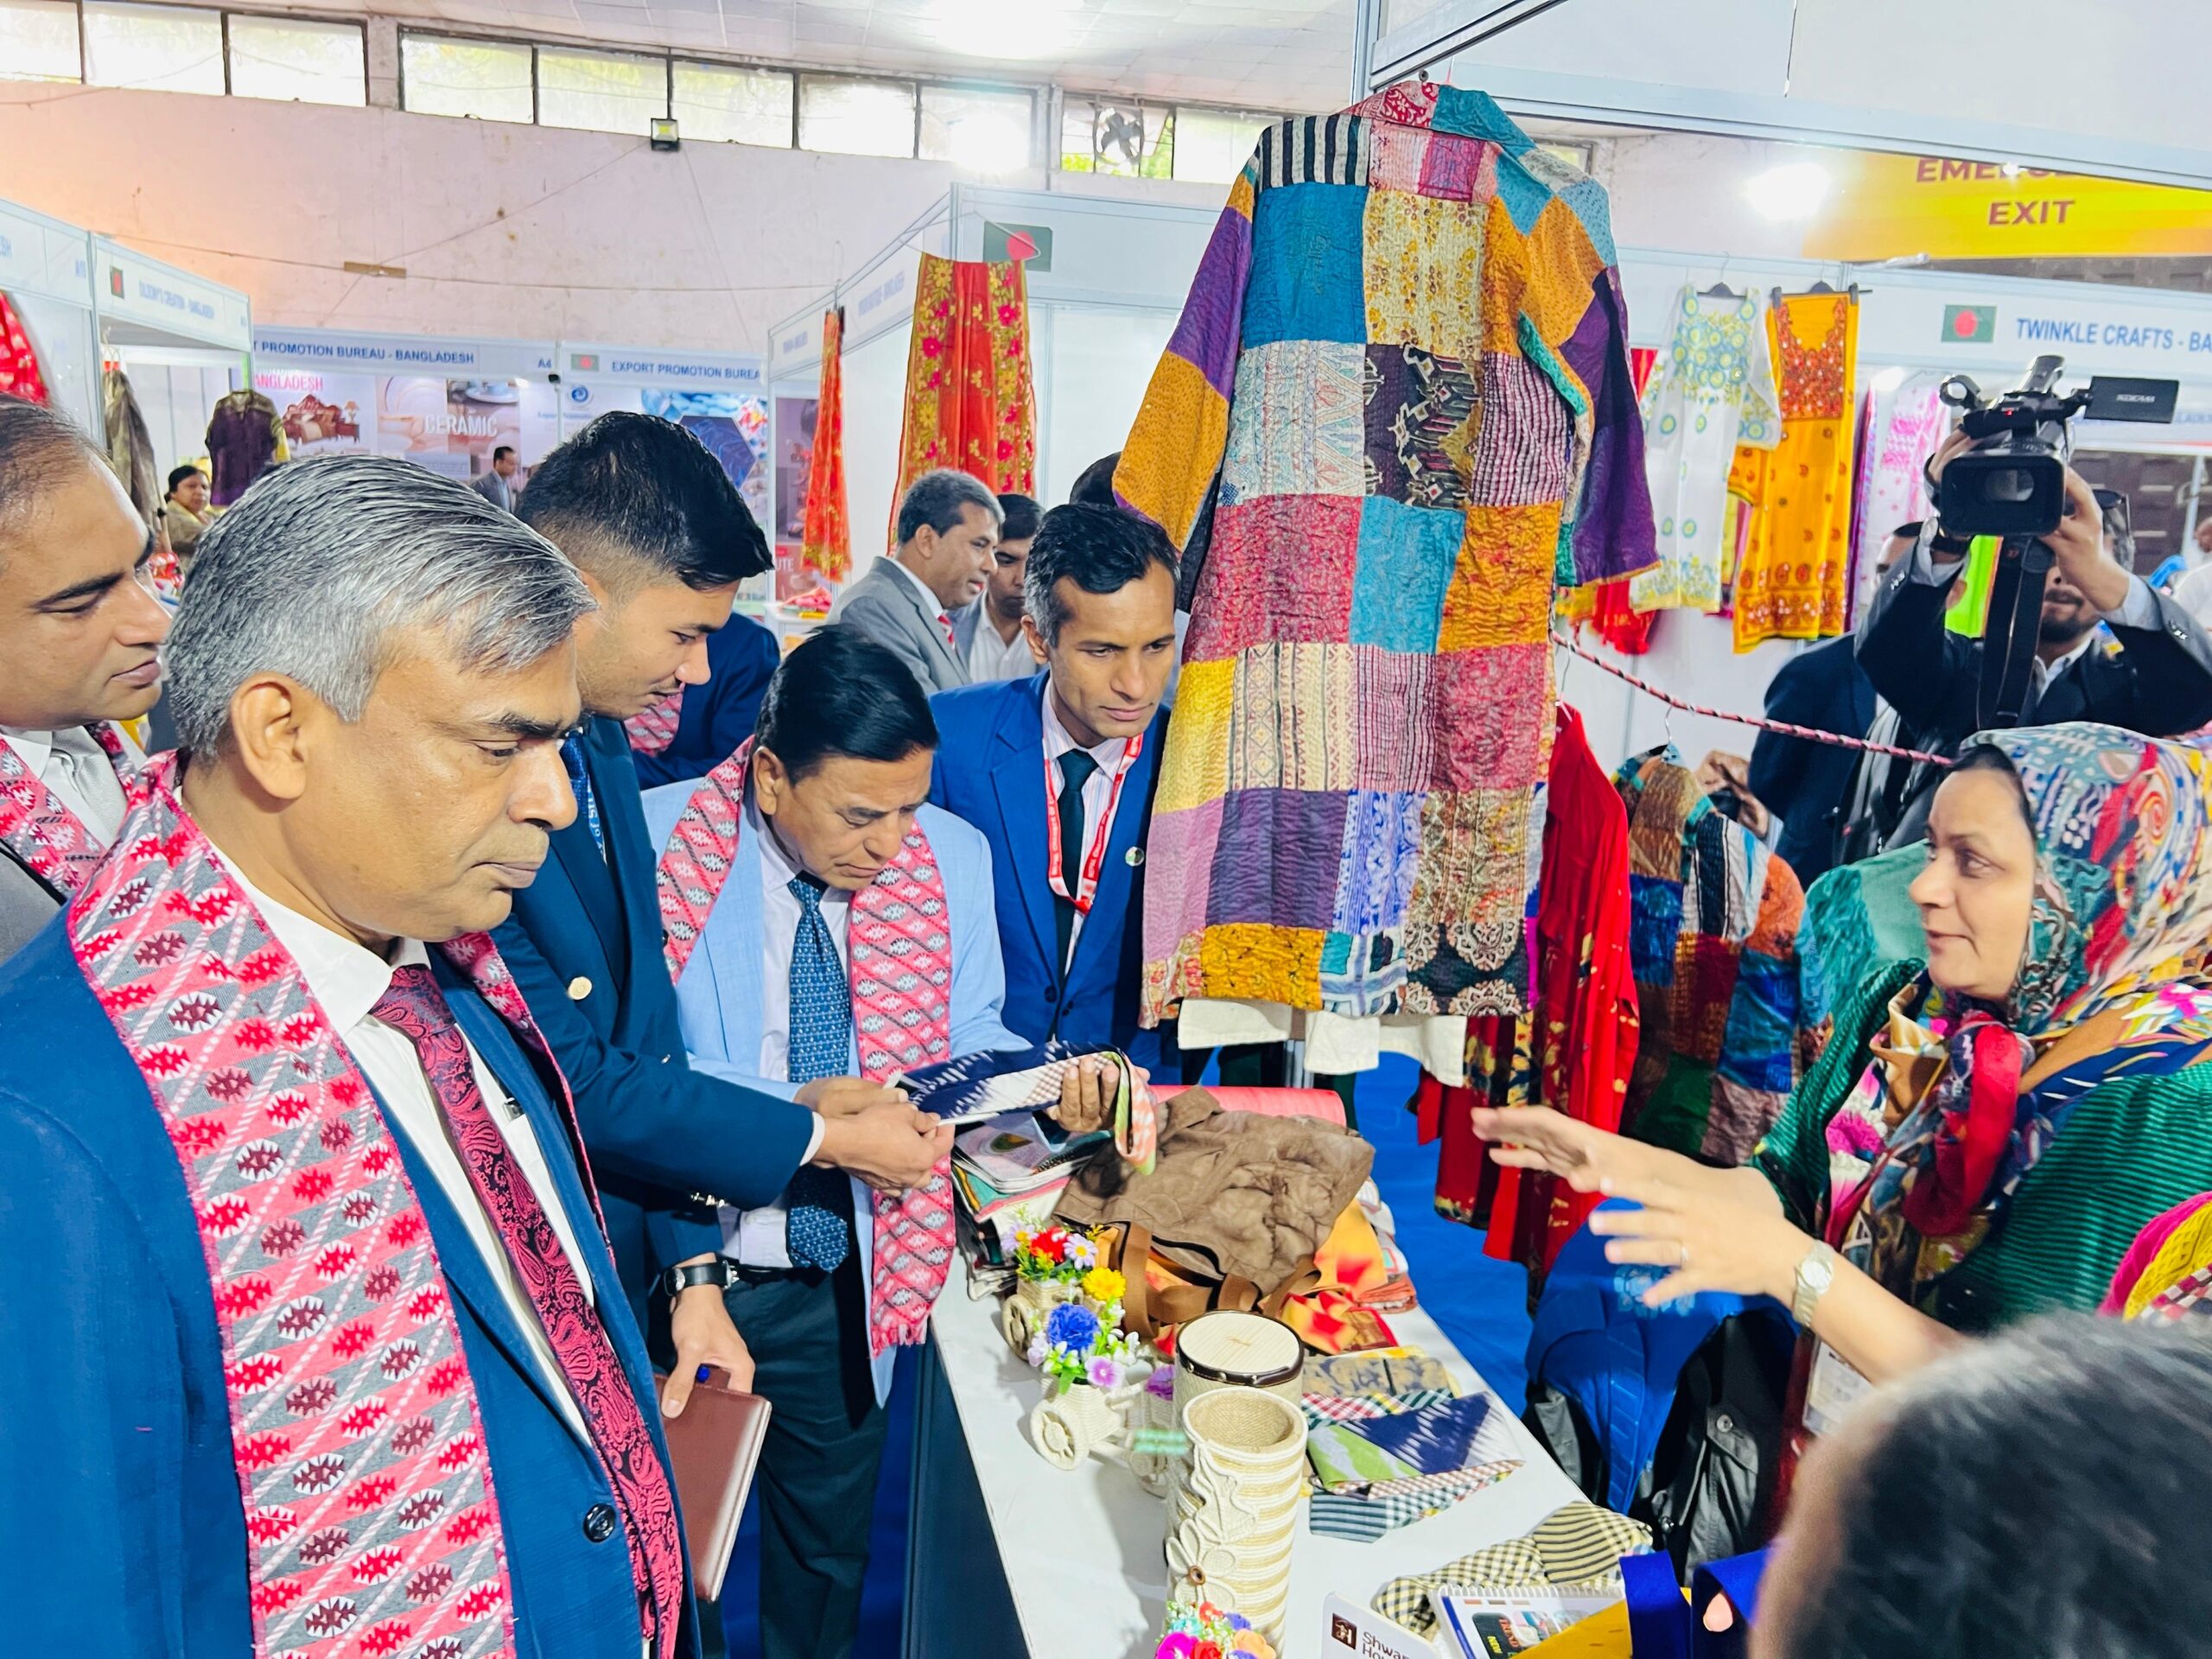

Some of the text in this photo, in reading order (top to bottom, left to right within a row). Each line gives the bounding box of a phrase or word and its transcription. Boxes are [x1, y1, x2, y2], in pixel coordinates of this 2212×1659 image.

[1988, 200, 2075, 226] EXIT
[2016, 318, 2100, 345] TWINKLE
[2102, 324, 2174, 350] CRAFTS
[262, 340, 334, 356] PROMOTION
[336, 345, 385, 360] BUREAU
[395, 349, 474, 365] BANGLADESH
[611, 360, 655, 374] EXPORT
[658, 364, 722, 378] PROMOTION
[423, 414, 499, 438] CERAMIC
